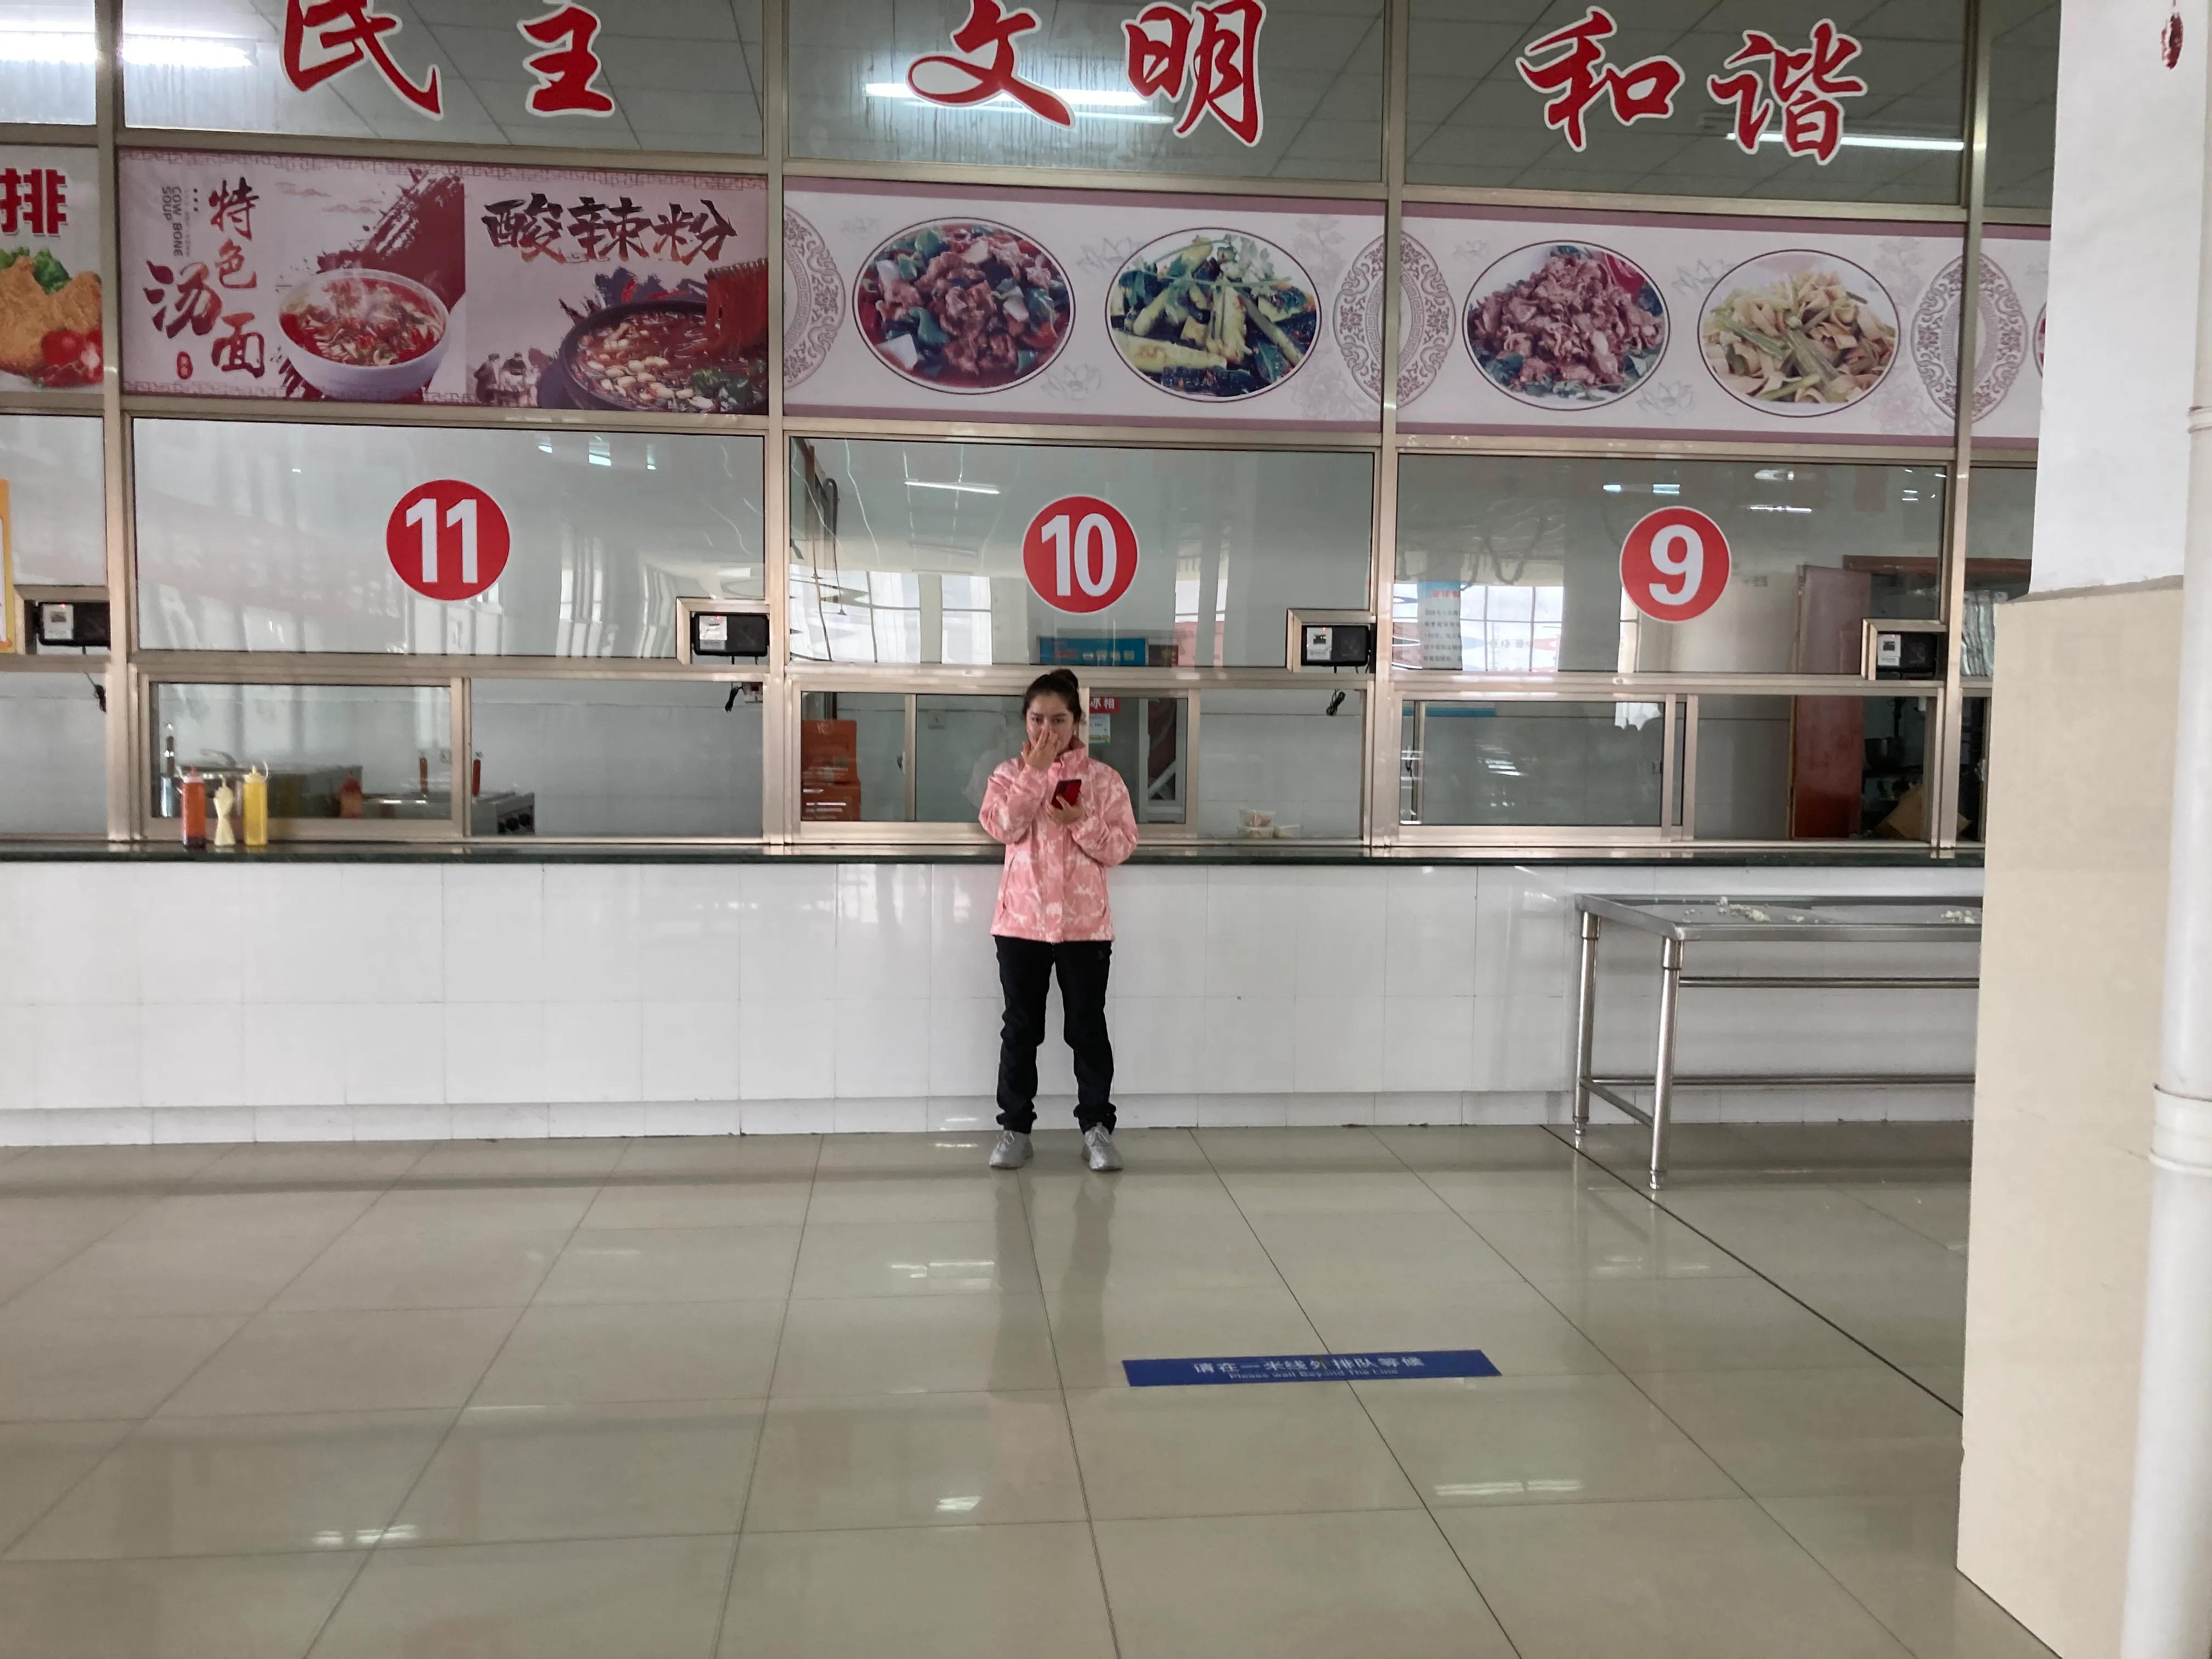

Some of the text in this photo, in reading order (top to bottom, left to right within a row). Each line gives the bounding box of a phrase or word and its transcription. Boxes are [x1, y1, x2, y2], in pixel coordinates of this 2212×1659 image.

[281, 0, 1867, 164] 民主 文明 和谐
[0, 168, 67, 235] 排
[162, 187, 172, 221] SOUP
[173, 223, 183, 256] BONE
[208, 177, 259, 289] 特色
[481, 192, 738, 266] 酸辣粉
[406, 498, 478, 584] 11
[1041, 513, 1117, 597] 10
[1649, 524, 1704, 606] 9
